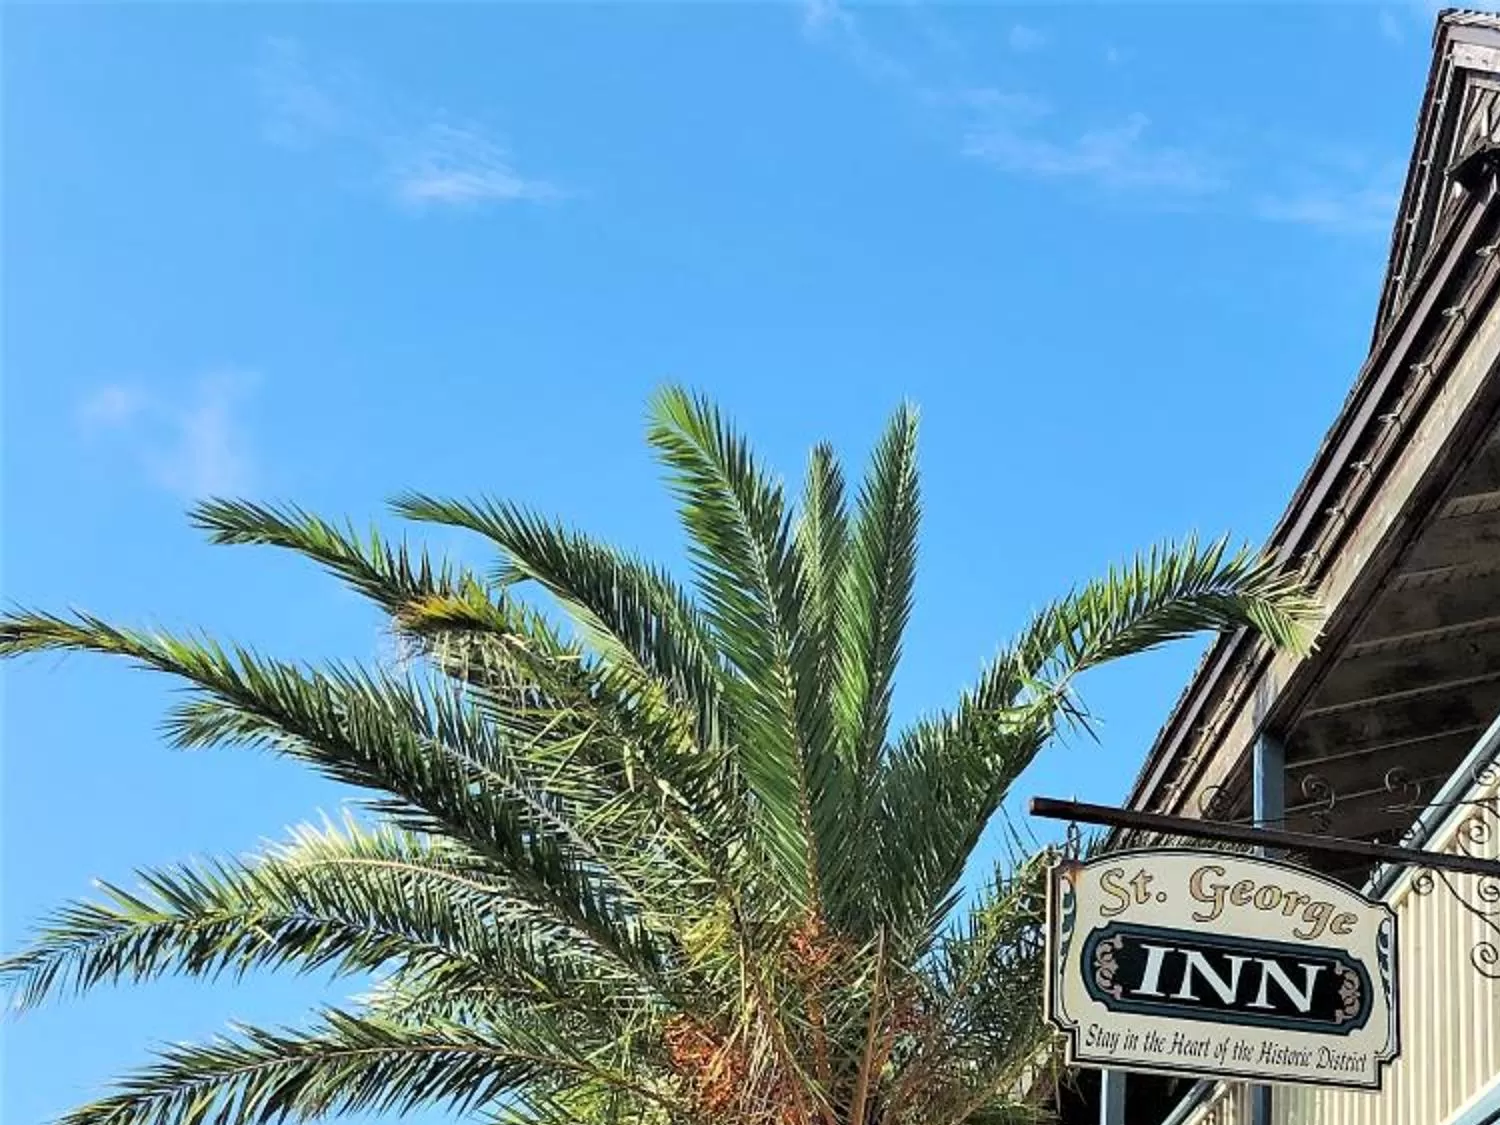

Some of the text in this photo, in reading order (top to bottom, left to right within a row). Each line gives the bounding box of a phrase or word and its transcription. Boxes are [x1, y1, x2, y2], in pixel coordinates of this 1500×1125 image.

[1099, 865, 1358, 940] St. George
[1131, 943, 1327, 1014] INN
[1085, 1023, 1367, 1073] Stay in the Heart of the Historic District
